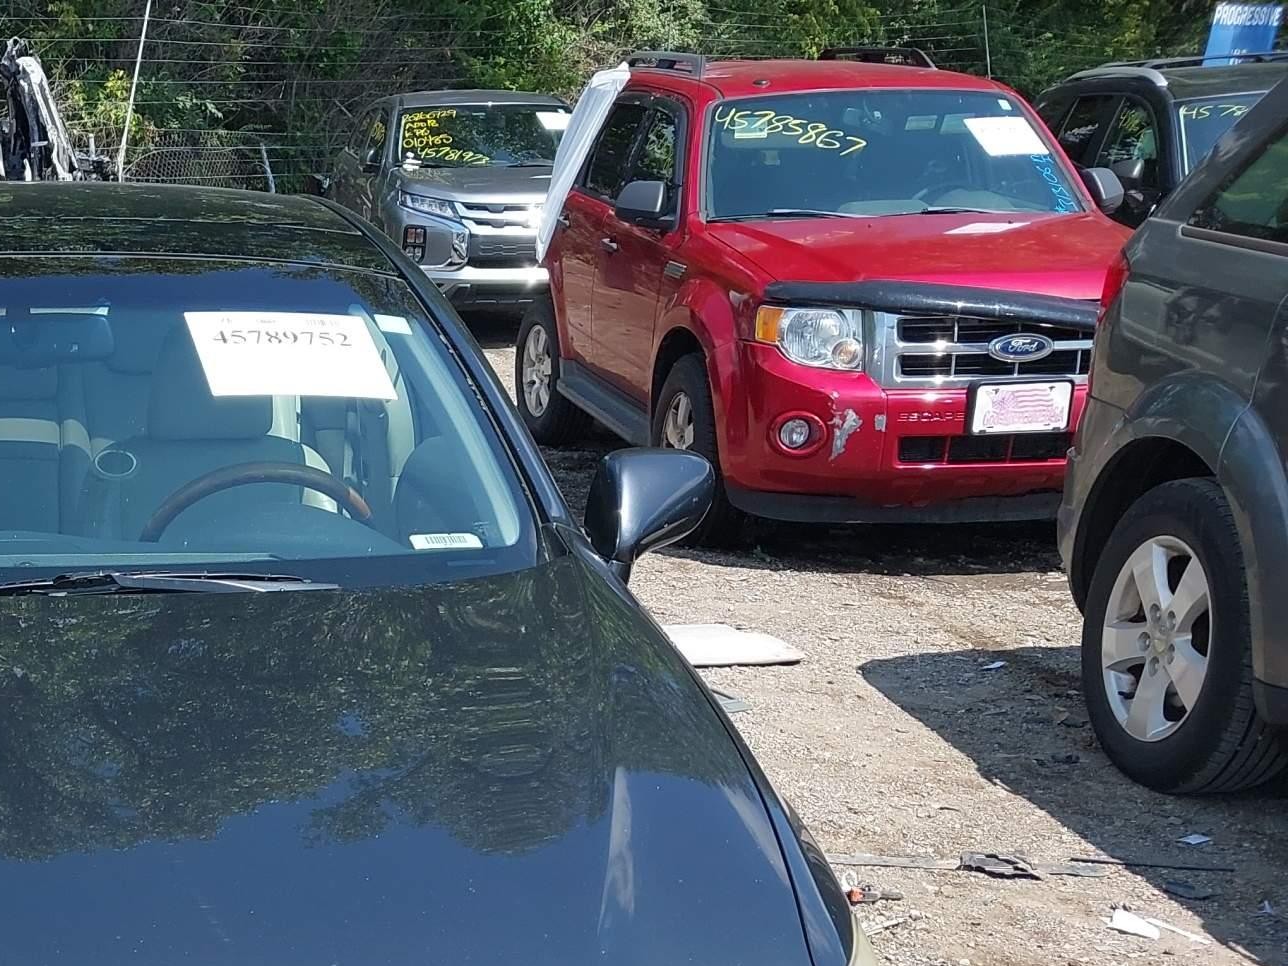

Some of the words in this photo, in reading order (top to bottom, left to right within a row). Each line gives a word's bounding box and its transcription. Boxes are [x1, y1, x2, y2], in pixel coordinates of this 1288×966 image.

[1213, 3, 1284, 26] PROGRESSIVE
[715, 106, 867, 156] 45785867
[212, 330, 353, 347] 45789752
[1008, 338, 1039, 353] Ford
[896, 412, 965, 422] ESCAPE
